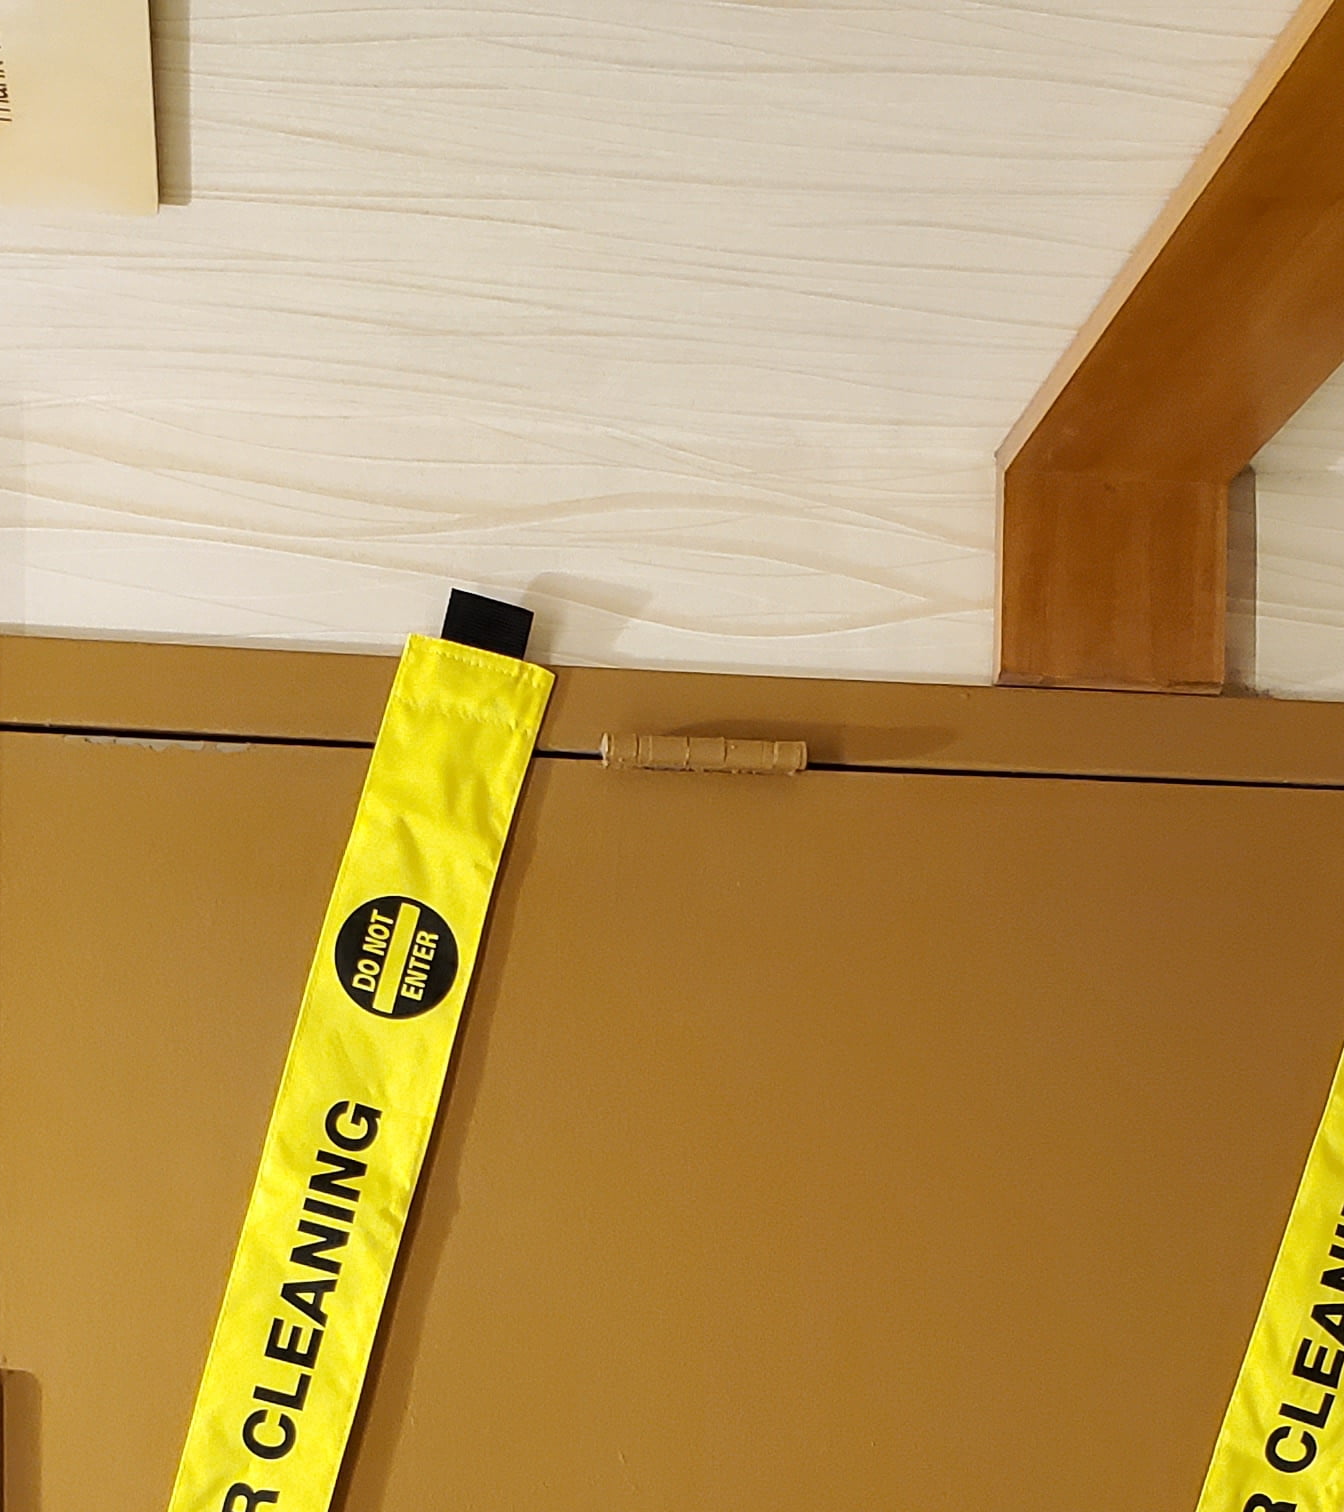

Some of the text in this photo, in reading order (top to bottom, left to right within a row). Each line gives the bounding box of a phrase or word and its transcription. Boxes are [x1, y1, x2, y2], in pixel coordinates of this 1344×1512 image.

[352, 908, 394, 993] DO NOT
[400, 930, 440, 1001] ENTER
[241, 1100, 383, 1460] CLEANING
